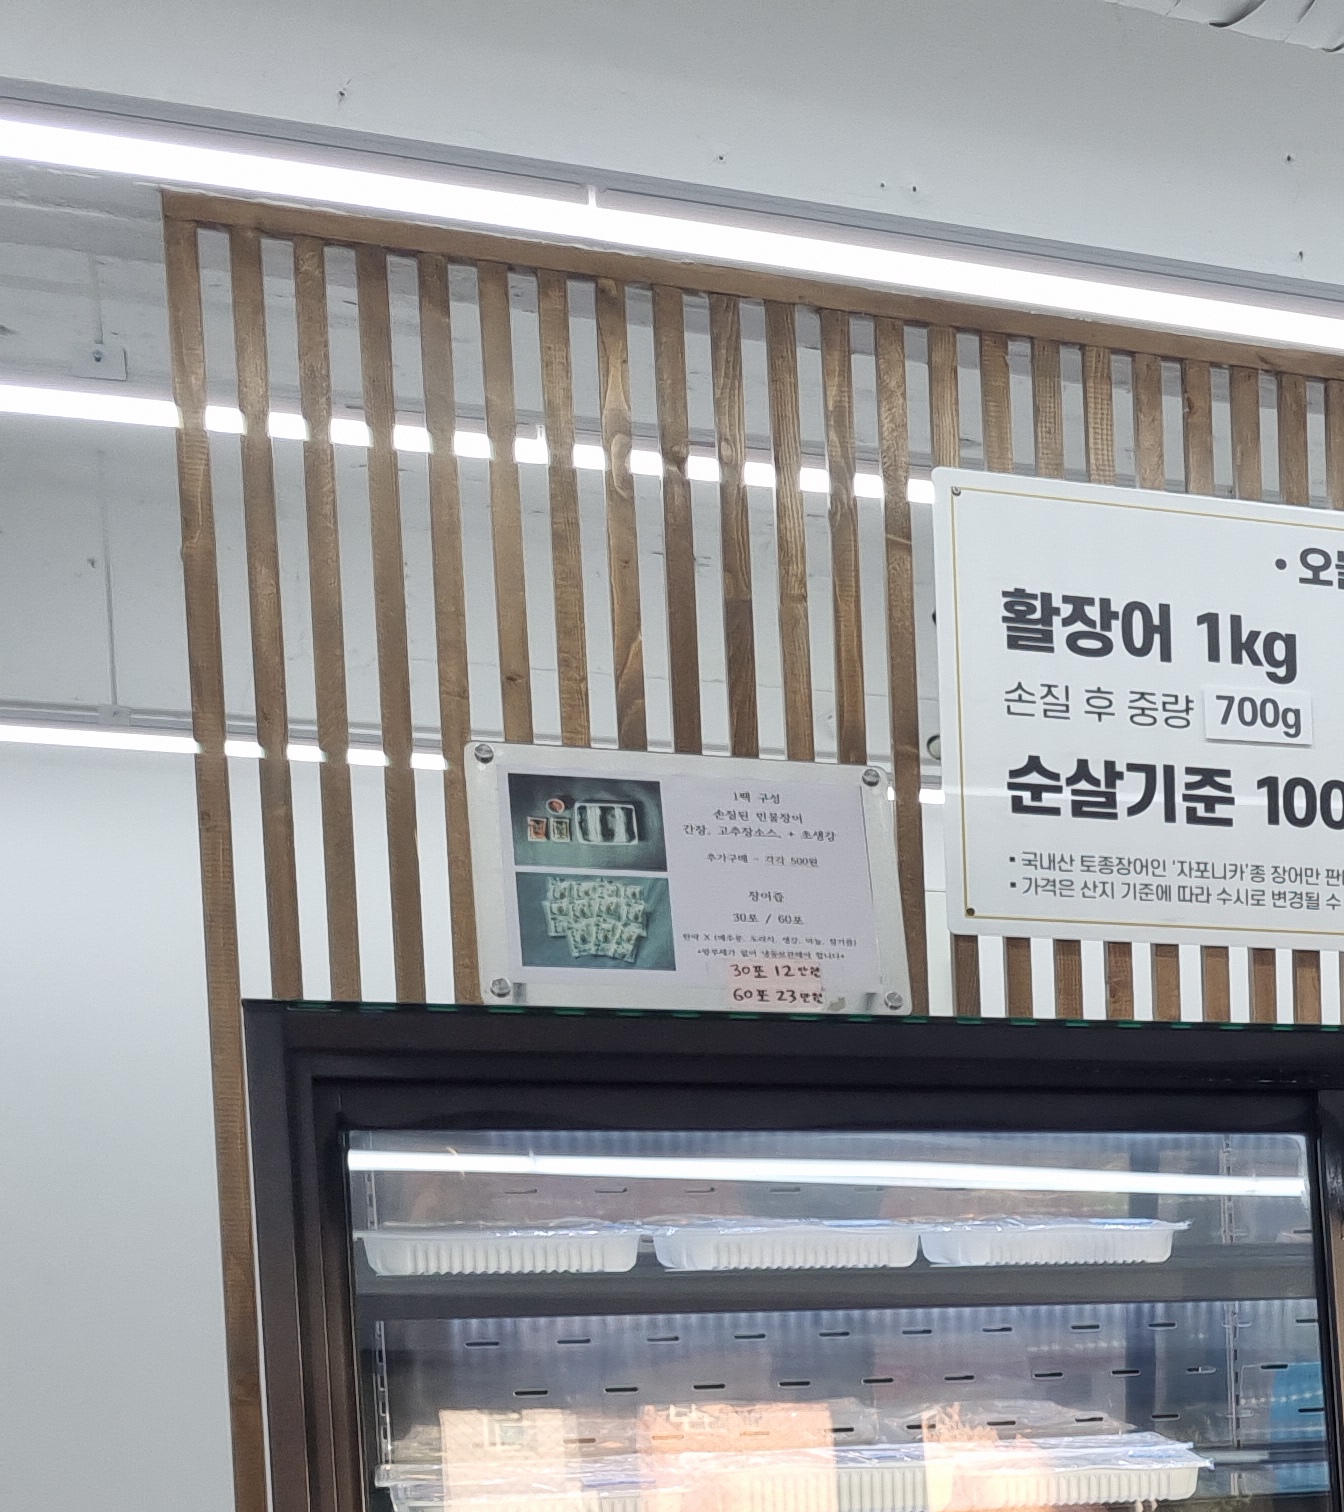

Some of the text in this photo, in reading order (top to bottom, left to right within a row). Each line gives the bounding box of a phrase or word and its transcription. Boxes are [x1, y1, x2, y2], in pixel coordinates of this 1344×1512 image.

[1001, 587, 1298, 684] 활장어 1kg
[1004, 681, 1301, 739] 손질 후 중량 700g
[1006, 755, 1235, 828] 순살기준
[1021, 851, 1075, 873] 국내산
[1080, 854, 1167, 878] 토종장어인
[1271, 865, 1321, 886] 장어만
[1022, 877, 1075, 898] 가격은
[1080, 880, 1115, 899] 산지
[1121, 882, 1172, 902] 기준에
[1177, 885, 1212, 904] 따라
[1216, 887, 1266, 907] 수시로
[1271, 890, 1320, 910] 변경될
[1325, 893, 1342, 910] 수
[730, 963, 768, 979] 30포
[733, 988, 770, 1002] 60포
